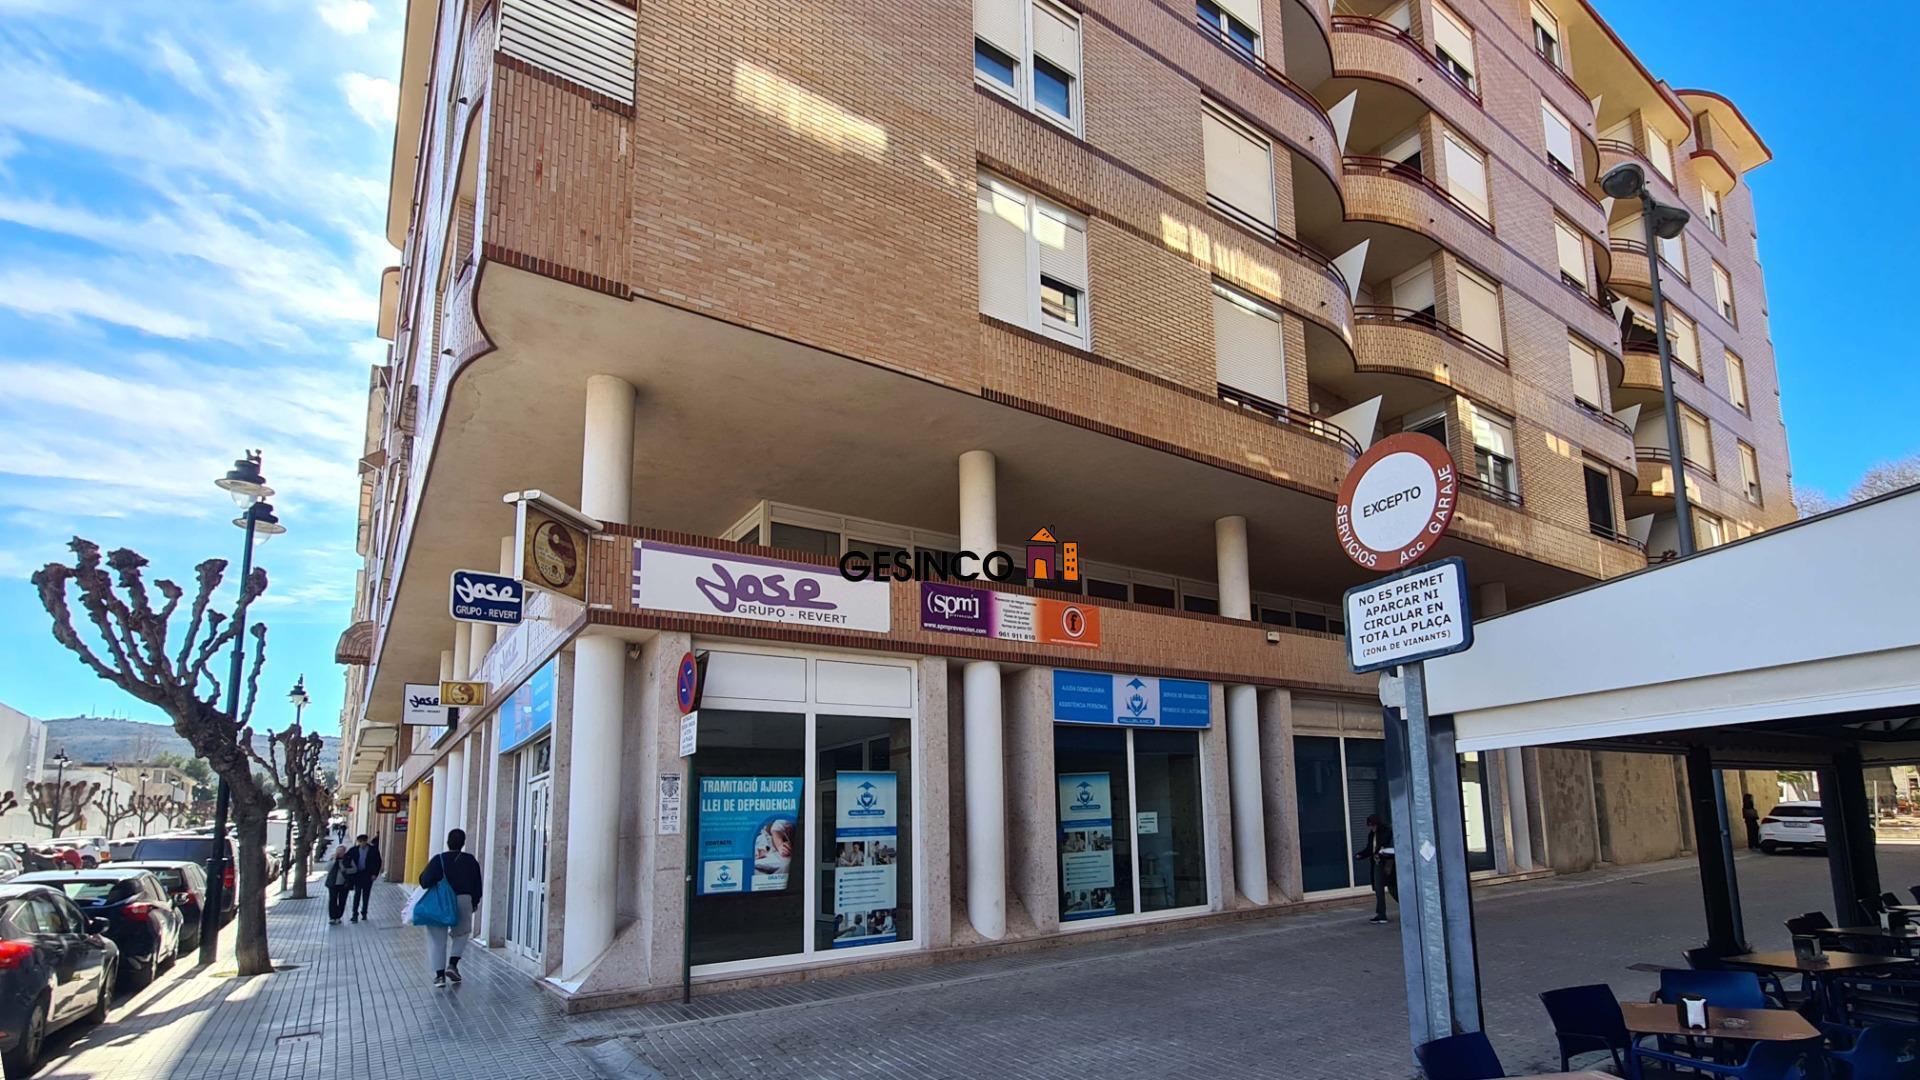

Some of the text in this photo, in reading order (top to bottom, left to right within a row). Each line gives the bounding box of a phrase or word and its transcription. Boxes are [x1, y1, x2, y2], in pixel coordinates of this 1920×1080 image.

[1337, 463, 1456, 567] SERVICIOS Acc GARAJE
[1363, 485, 1422, 518] EXCEPTO
[455, 577, 521, 604] Jose
[695, 562, 838, 613] Jose
[1358, 573, 1445, 607] NO ES PERMET
[455, 605, 482, 615] GRUPO
[488, 608, 518, 620] REVERT
[737, 603, 786, 619] GRUPO
[798, 609, 848, 625] REVERT
[1363, 600, 1444, 631] CIRCULAR EN
[1365, 588, 1439, 618] APARCAR NI
[1359, 614, 1452, 645] TOTA LA PLAÇA
[1362, 629, 1451, 658] (ZONA DE VIANANTS)
[702, 778, 794, 793] TRAMITACIÓ AJUDES
[702, 798, 796, 812] LLEI DE DEPENDENCIA
